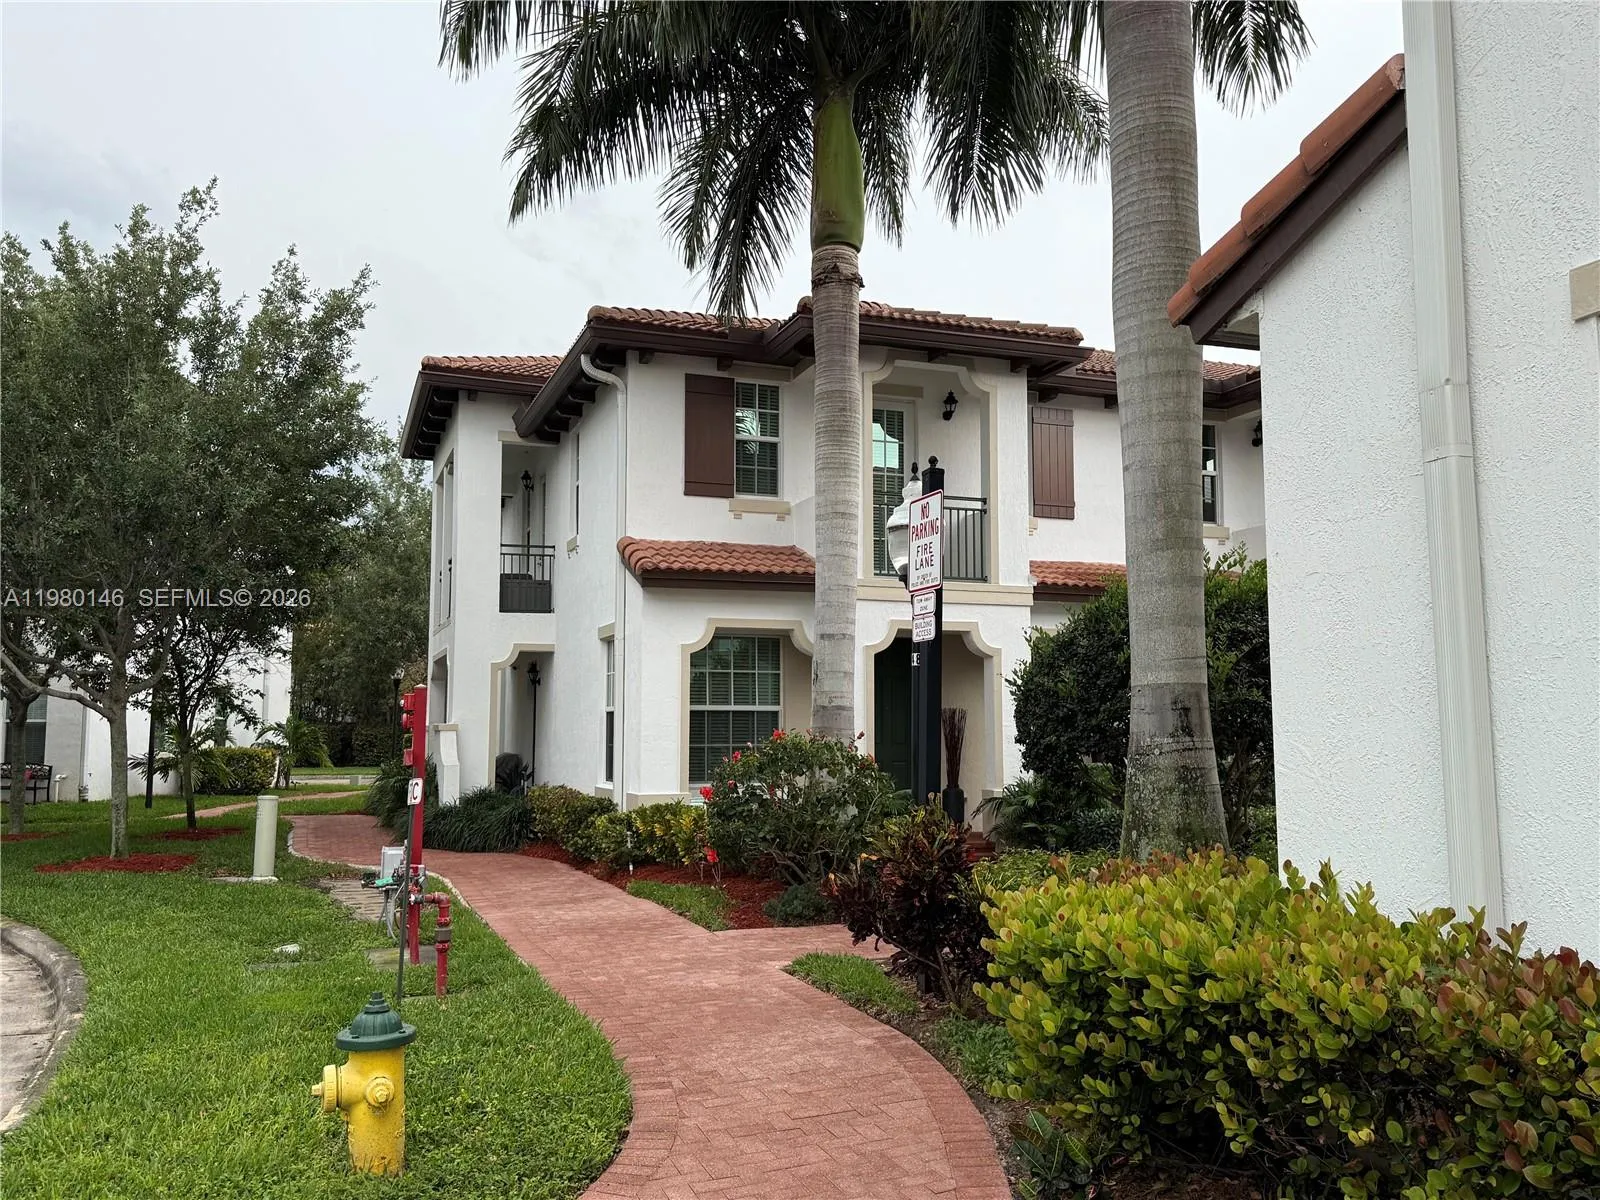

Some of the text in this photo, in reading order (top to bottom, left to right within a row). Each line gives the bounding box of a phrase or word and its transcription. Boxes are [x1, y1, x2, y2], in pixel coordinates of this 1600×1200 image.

[921, 502, 929, 520] NO
[911, 517, 939, 542] PARKING
[916, 542, 933, 558] FIRE
[915, 555, 934, 571] LANE
[915, 620, 932, 630] BUILDING
[915, 628, 932, 637] ACCESS
